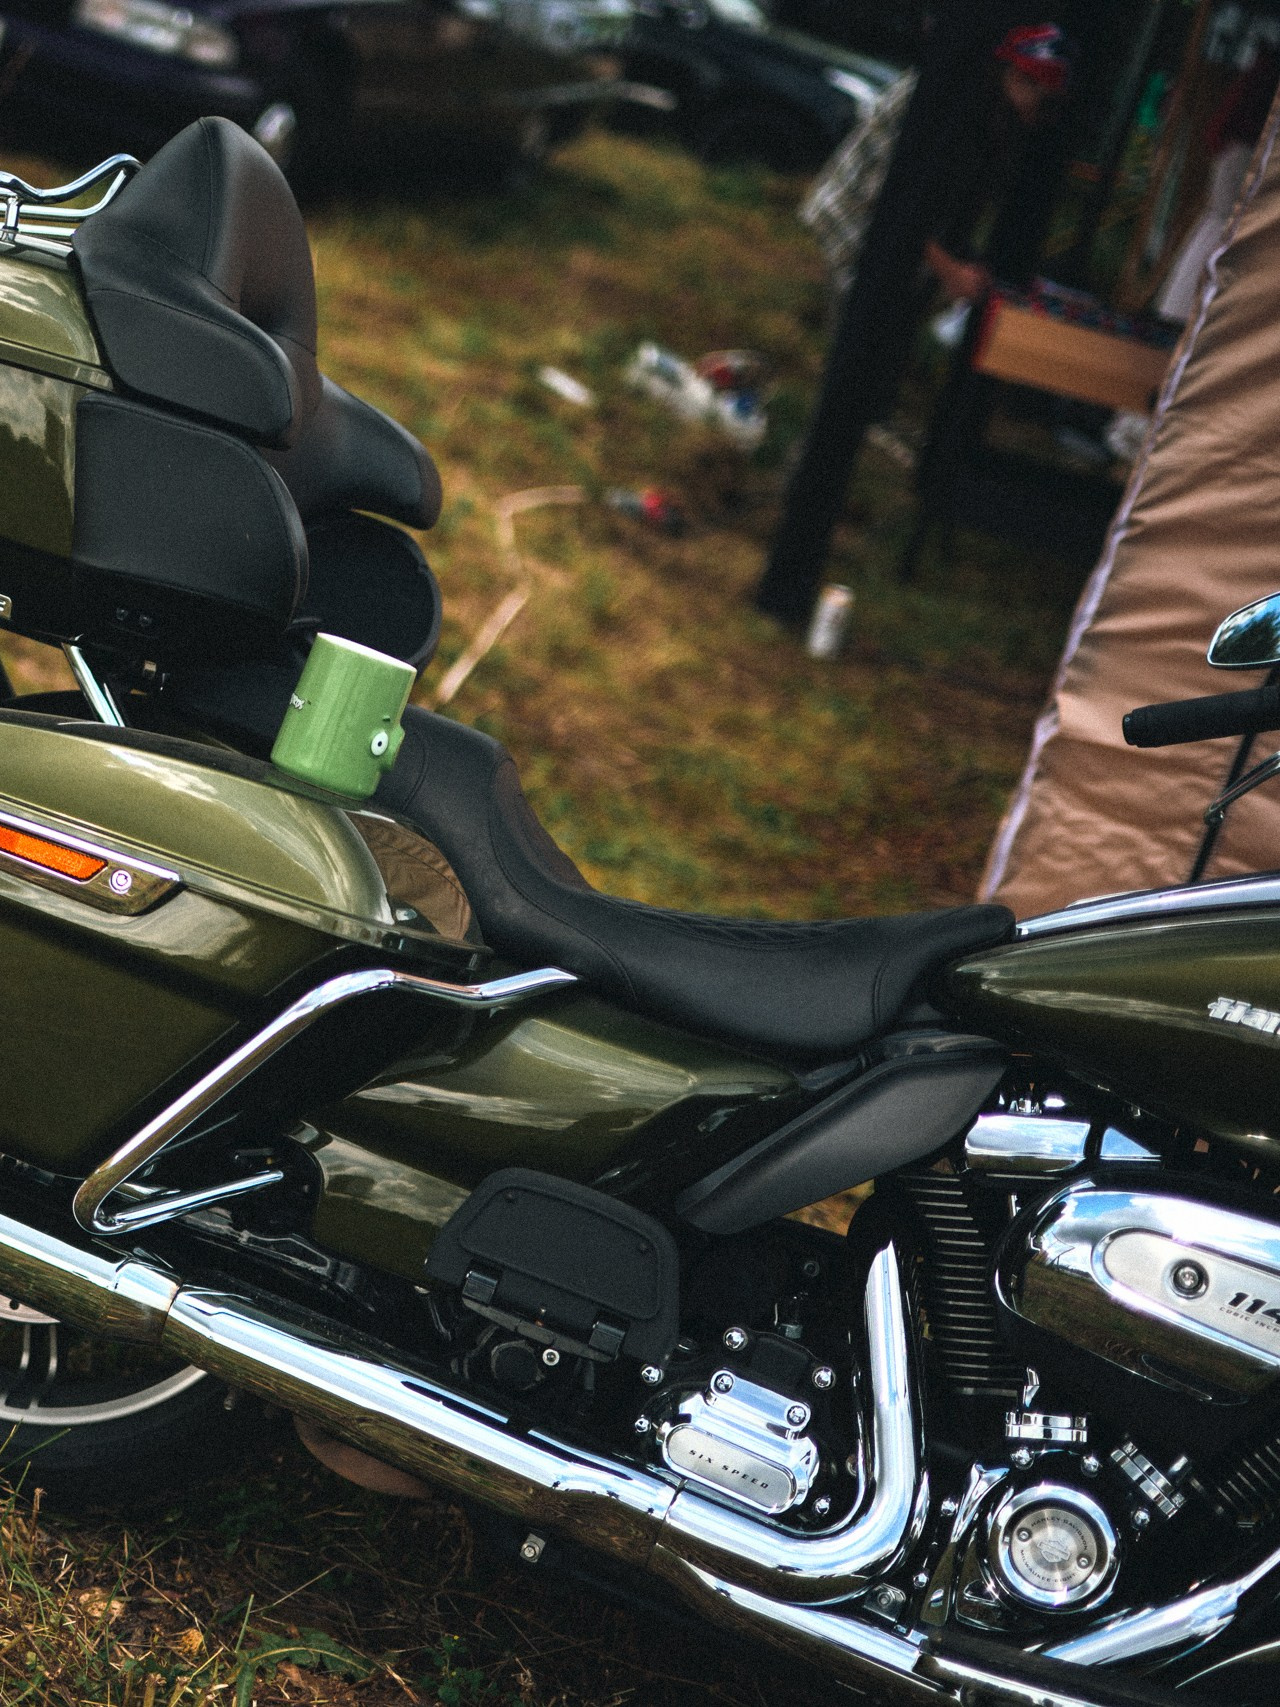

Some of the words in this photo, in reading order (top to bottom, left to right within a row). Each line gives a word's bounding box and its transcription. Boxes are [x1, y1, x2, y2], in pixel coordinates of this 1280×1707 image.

[1208, 996, 1280, 1035] Har
[1220, 1307, 1251, 1321] CUBIC
[1228, 1292, 1280, 1325] 114
[689, 1450, 713, 1464] SIX
[722, 1464, 769, 1489] SPEED
